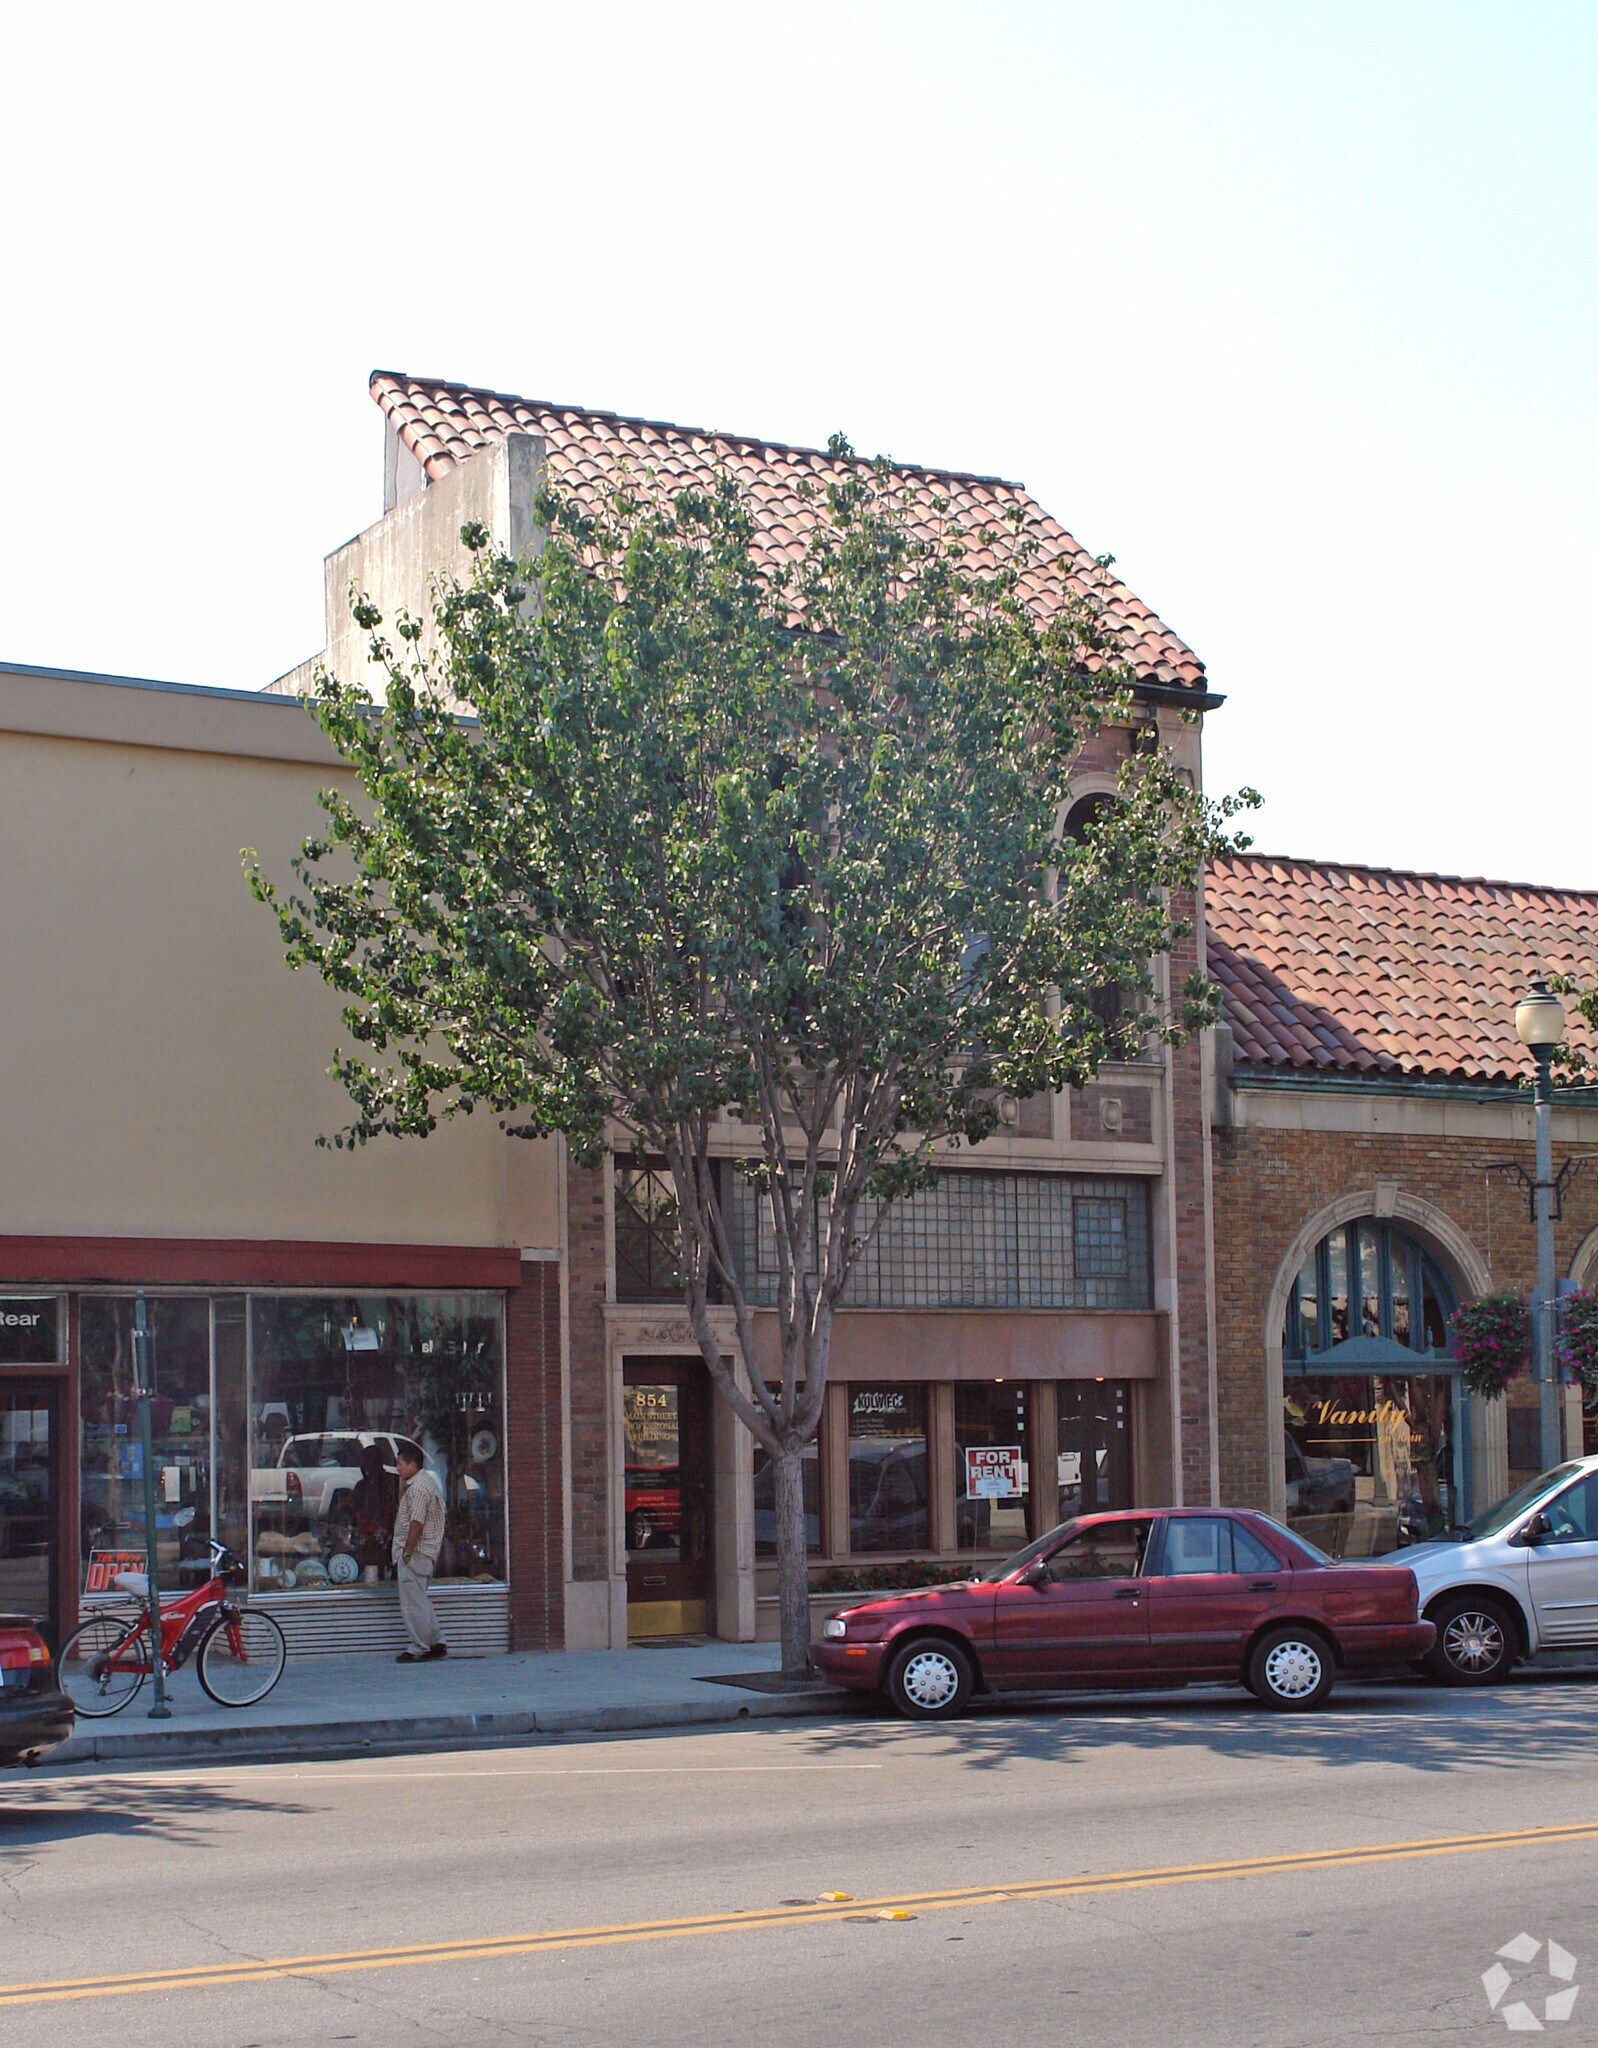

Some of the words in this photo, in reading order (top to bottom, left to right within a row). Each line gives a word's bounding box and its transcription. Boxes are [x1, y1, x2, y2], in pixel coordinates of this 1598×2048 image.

[636, 1393, 668, 1407] 854
[624, 1411, 644, 1420] MAIN
[647, 1411, 678, 1420] STREET
[1312, 1399, 1407, 1434] Vanity
[975, 1451, 1011, 1465] FOR
[970, 1465, 1014, 1478] RENT
